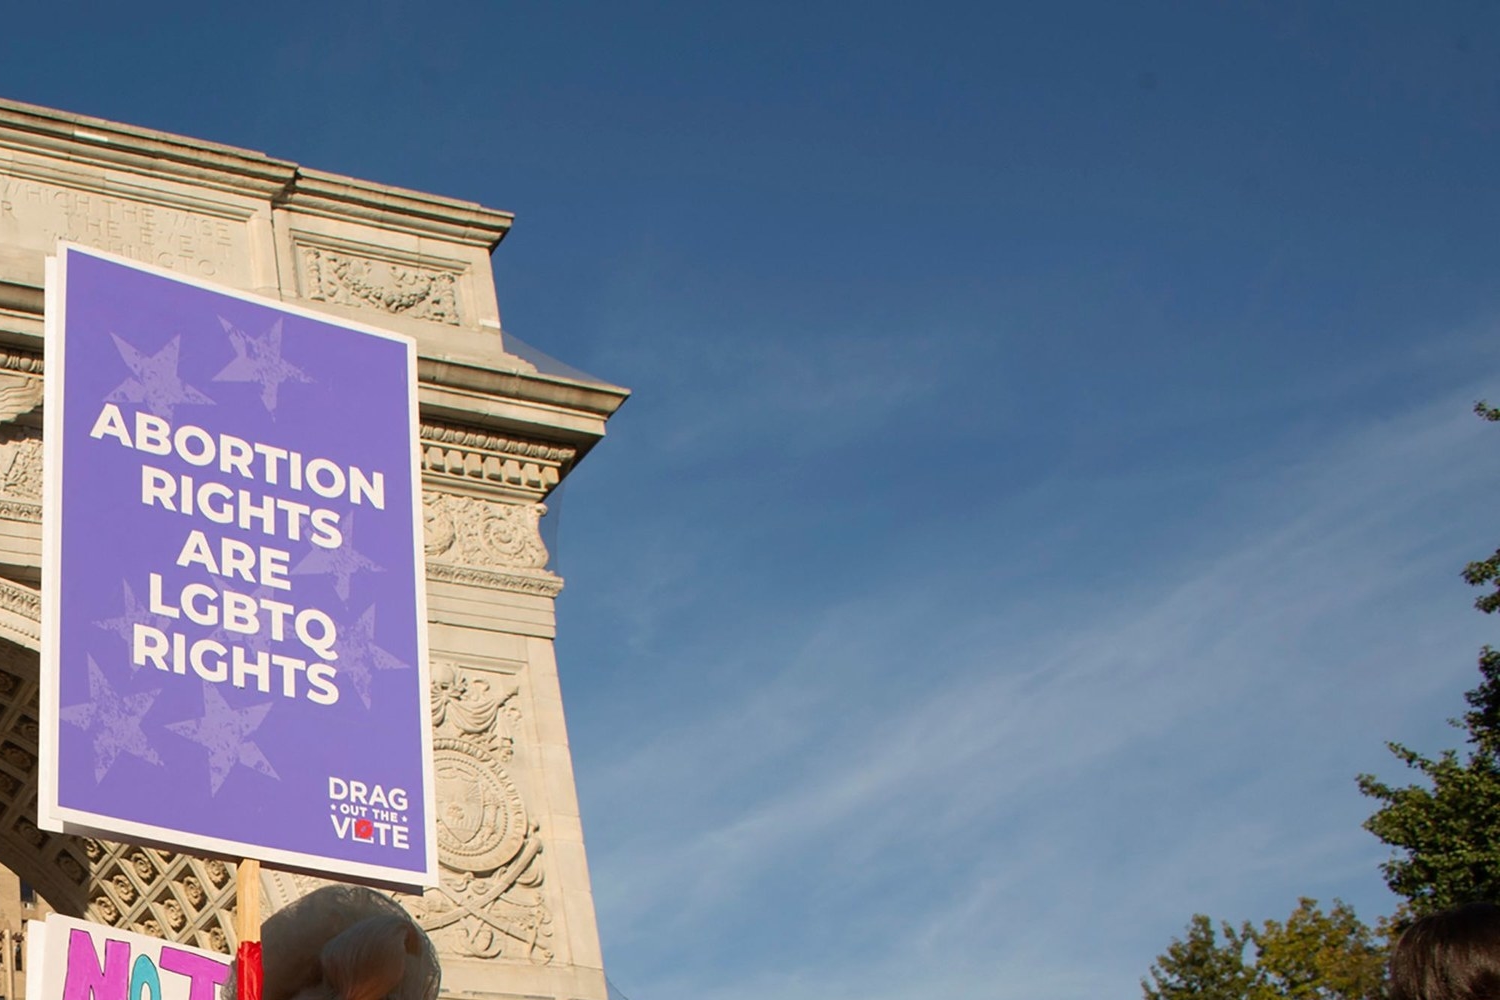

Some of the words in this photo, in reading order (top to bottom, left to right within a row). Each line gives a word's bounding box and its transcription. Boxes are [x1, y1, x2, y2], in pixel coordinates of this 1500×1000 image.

[65, 212, 123, 239] THE
[105, 199, 156, 226] THE
[89, 402, 385, 510] ABORTION
[141, 464, 343, 549] RIGHTS
[176, 529, 291, 591] ARE
[149, 572, 338, 660] LGBTQ
[133, 622, 340, 706] RIGHTS
[329, 776, 408, 811] DRAG
[340, 803, 367, 818] OUT
[372, 808, 398, 823] THE
[330, 814, 409, 849] VOTE
